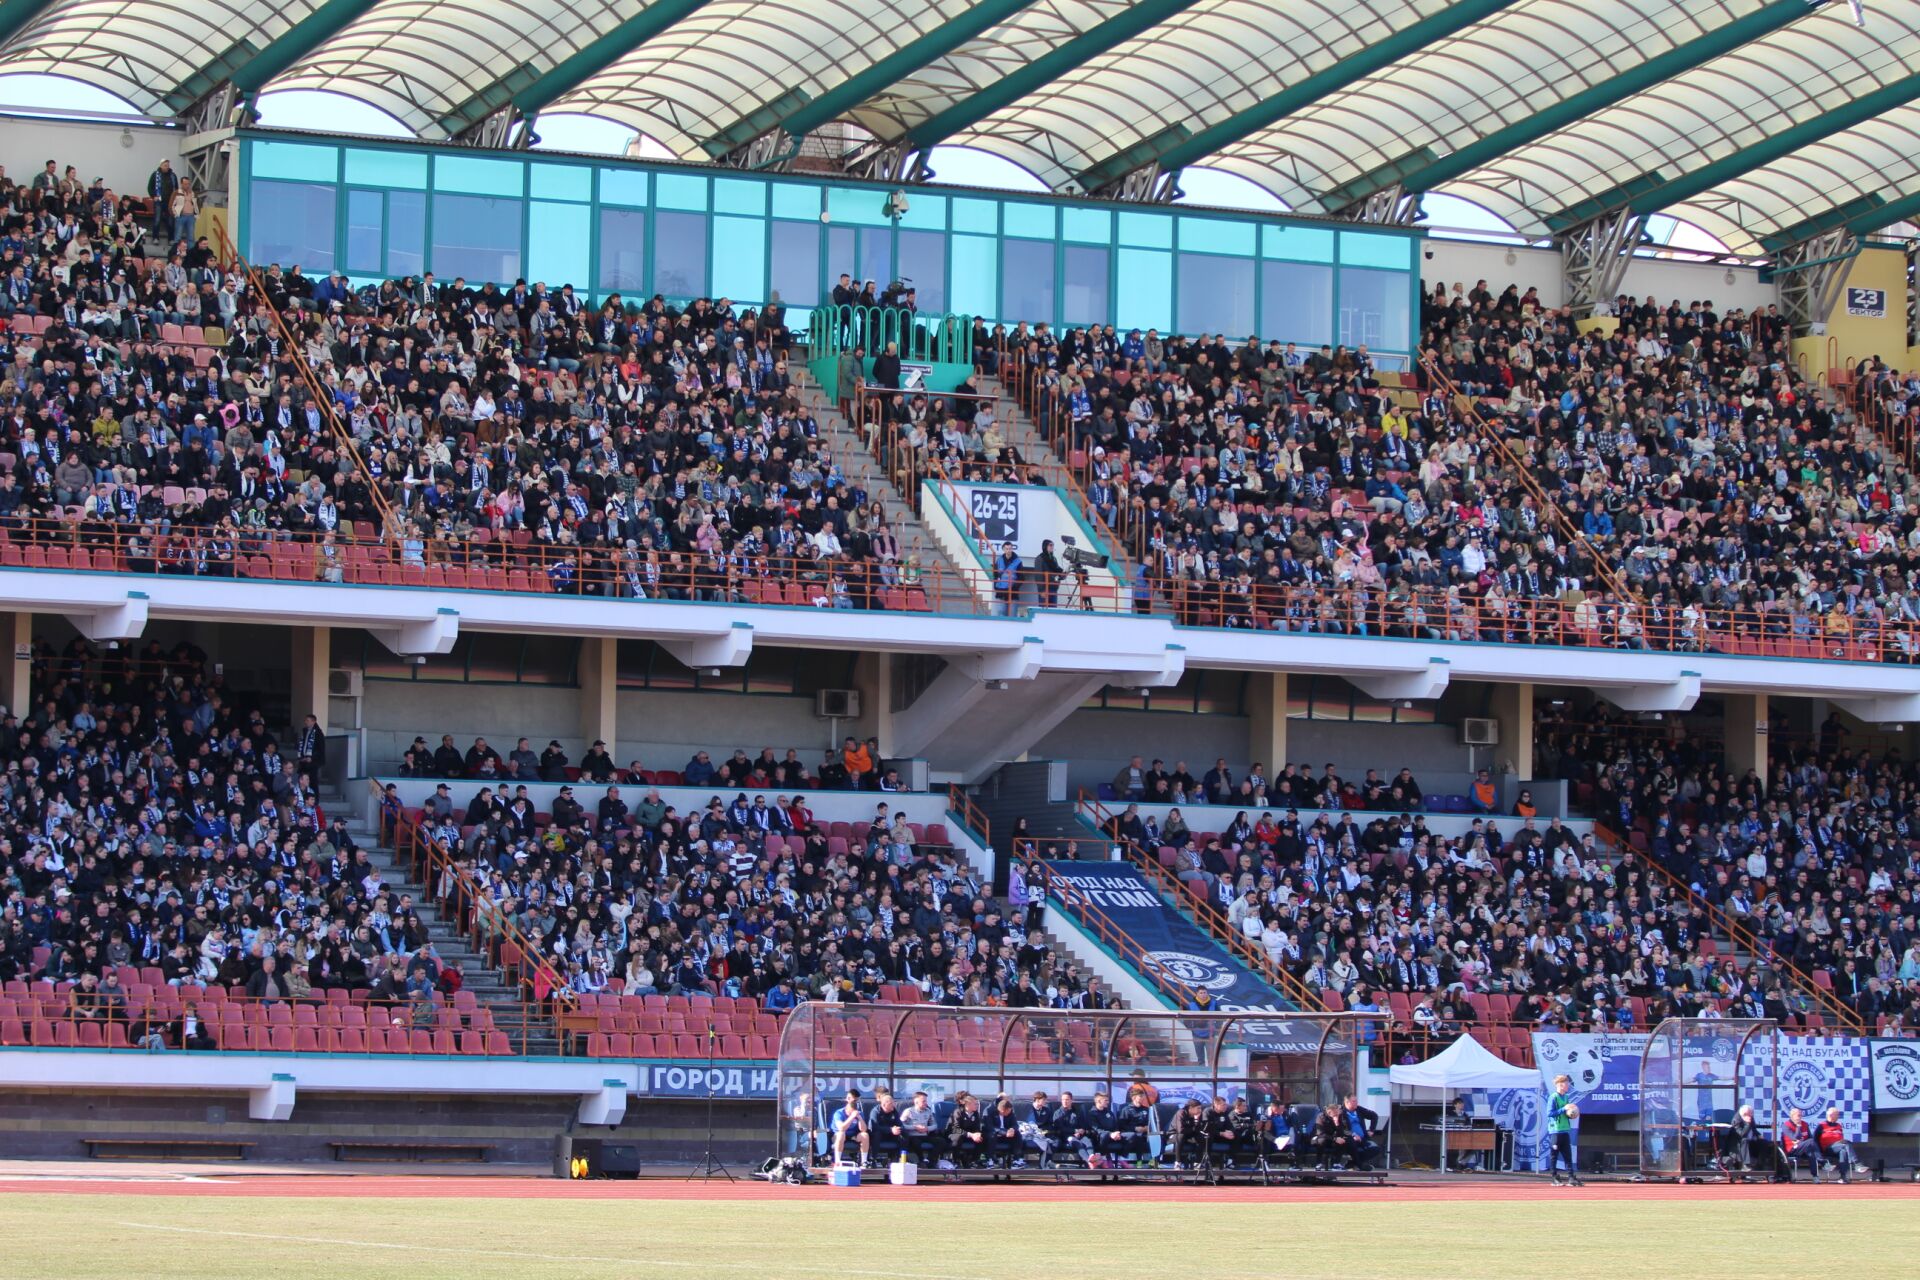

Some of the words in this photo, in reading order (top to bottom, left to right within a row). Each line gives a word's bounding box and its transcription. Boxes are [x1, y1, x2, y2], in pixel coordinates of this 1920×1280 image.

[1854, 290, 1878, 305] 23
[1849, 308, 1883, 316] СЕКТОР
[974, 494, 1016, 520] 26-25
[1049, 876, 1106, 890] ОРОД
[1101, 877, 1146, 890] НАД
[1792, 1048, 1812, 1057] НАД
[1815, 1048, 1849, 1057] БУГАМ
[653, 1067, 744, 1095] ГОРОД
[1591, 1093, 1624, 1102] ПОБЕДА
